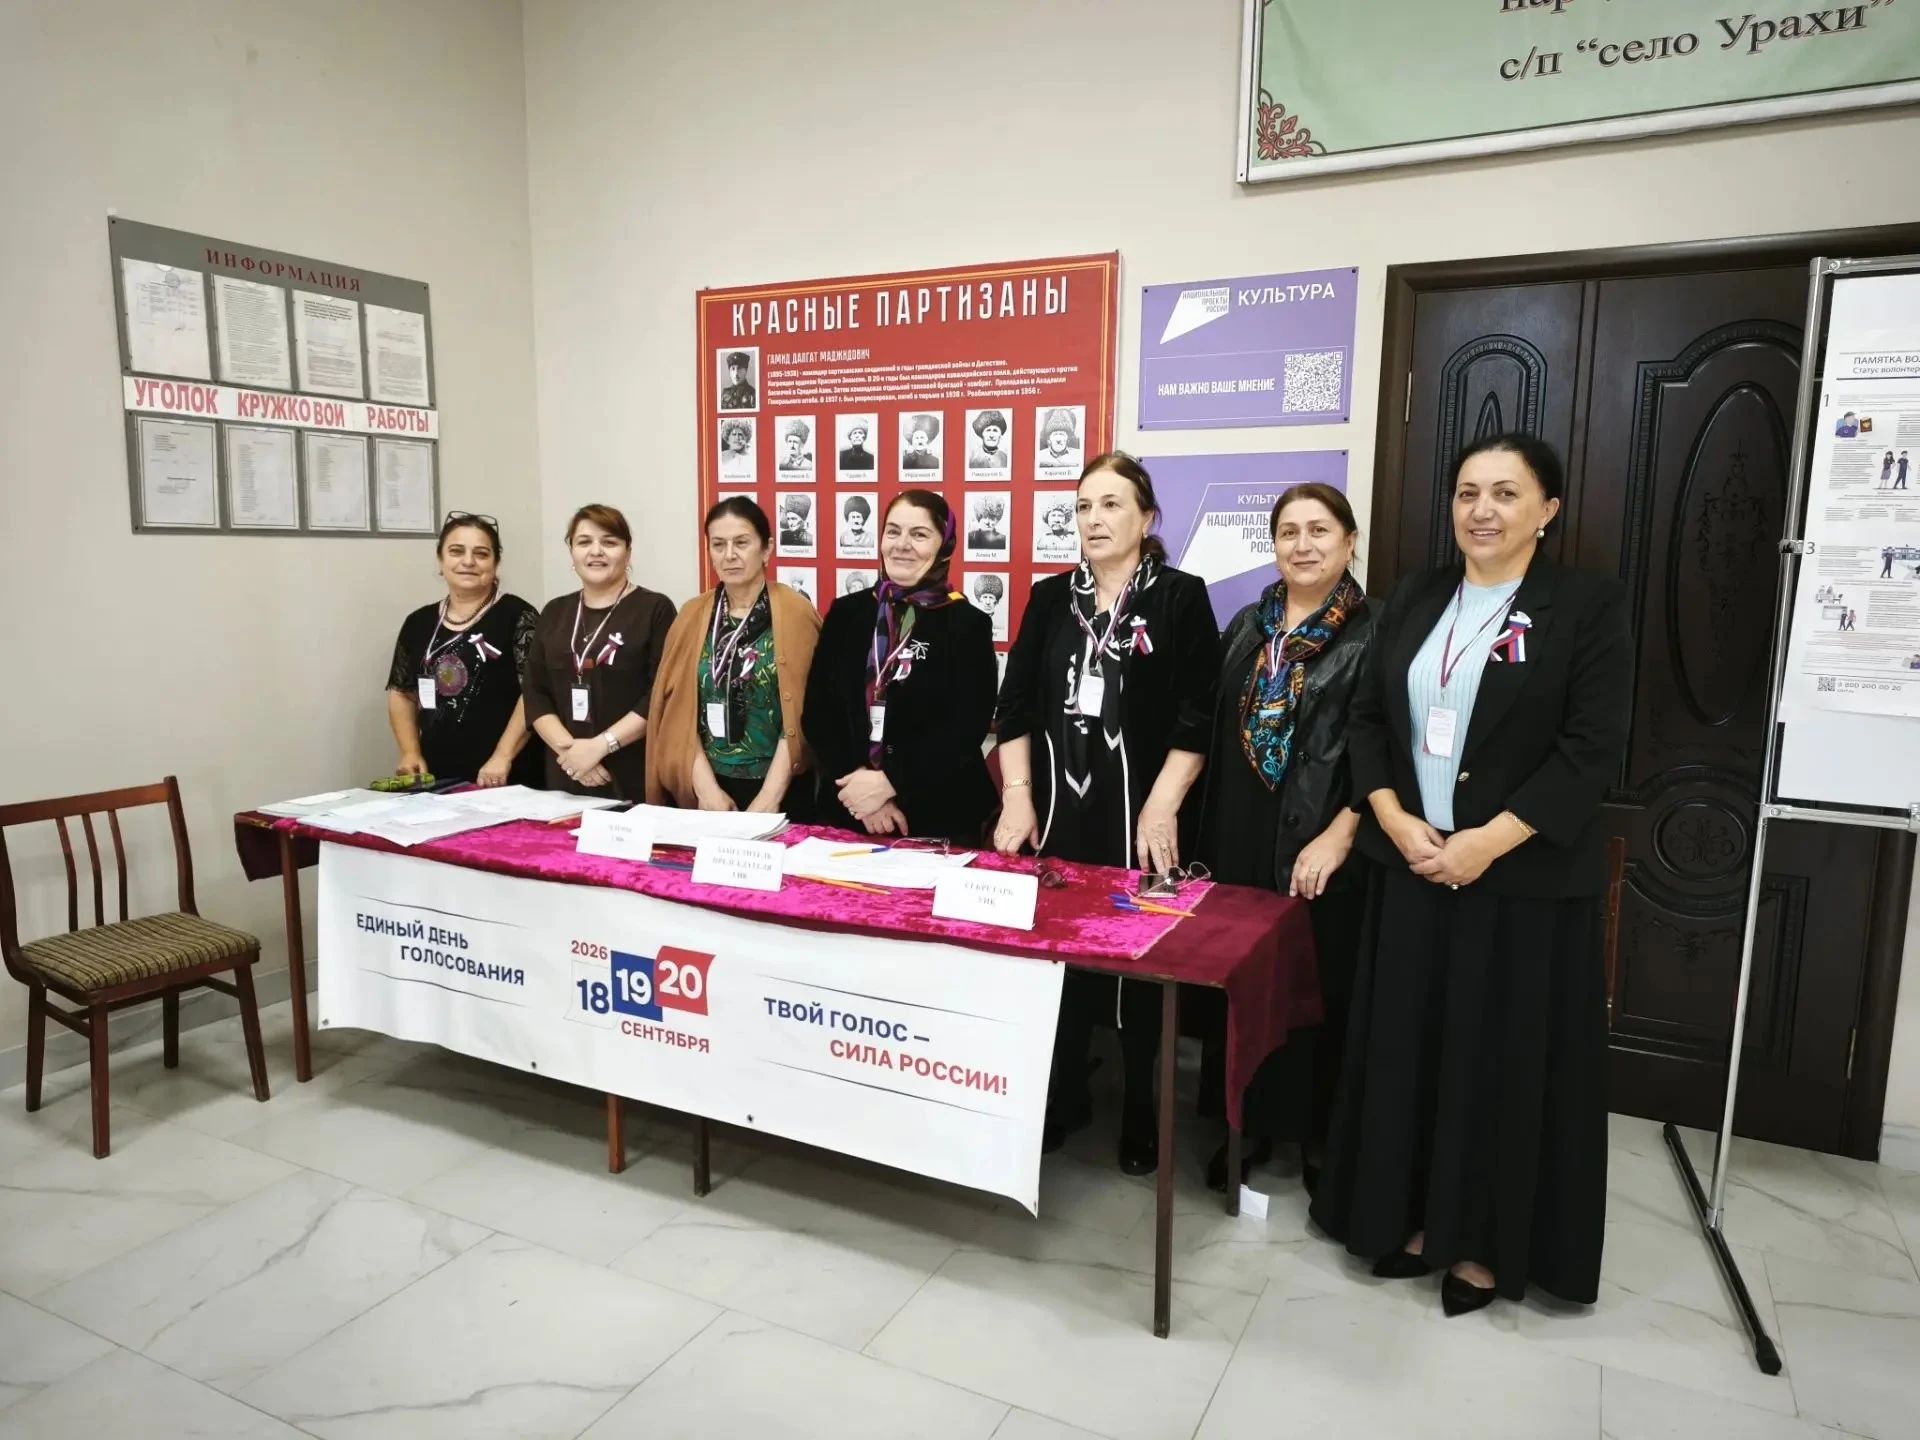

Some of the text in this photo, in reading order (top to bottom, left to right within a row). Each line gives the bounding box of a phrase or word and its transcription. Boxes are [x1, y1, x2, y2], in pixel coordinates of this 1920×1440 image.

[1500, 46, 1563, 81] с/п
[206, 250, 360, 291] ИНФОРМАЦИЯ
[1182, 289, 1228, 299] НАЦИОНАЛЬНЫЕ
[1201, 297, 1228, 305] ПРОЕКТЫ
[1238, 282, 1336, 306] КУЛЬТУРА
[732, 275, 1068, 337] КРАСНЫЕ ПАРТИЗАНЫ
[1854, 354, 1920, 365] ПАМЯТКА ВО
[1853, 366, 1879, 375] Статус
[1158, 378, 1275, 396] НАМ ВАЖНО ВАШЕ МНЕНИЕ
[134, 378, 218, 414] УГОЛОК
[366, 406, 429, 432] РАБОТЫ
[1823, 394, 1830, 408] 1
[1237, 494, 1279, 505] КУЛЬТУ
[1207, 513, 1269, 527] НАЦИОНАЛЬ
[1242, 527, 1273, 540] ПРОЕ
[1250, 541, 1275, 553] РОСС
[1805, 542, 1815, 554] 3
[356, 913, 468, 950] ЕДИНЫЙ ДЕНЬ
[571, 939, 608, 960] 2026
[400, 945, 525, 986] ГОЛОСОВАНИЯ
[576, 960, 703, 1014] 18 19 20
[764, 996, 823, 1026] ТВОЙ
[830, 1010, 908, 1042] ГОЛОС
[620, 1020, 710, 1054] СЕНТЯБРЯ
[830, 1039, 1008, 1096] СИЛА РОССИИ!
